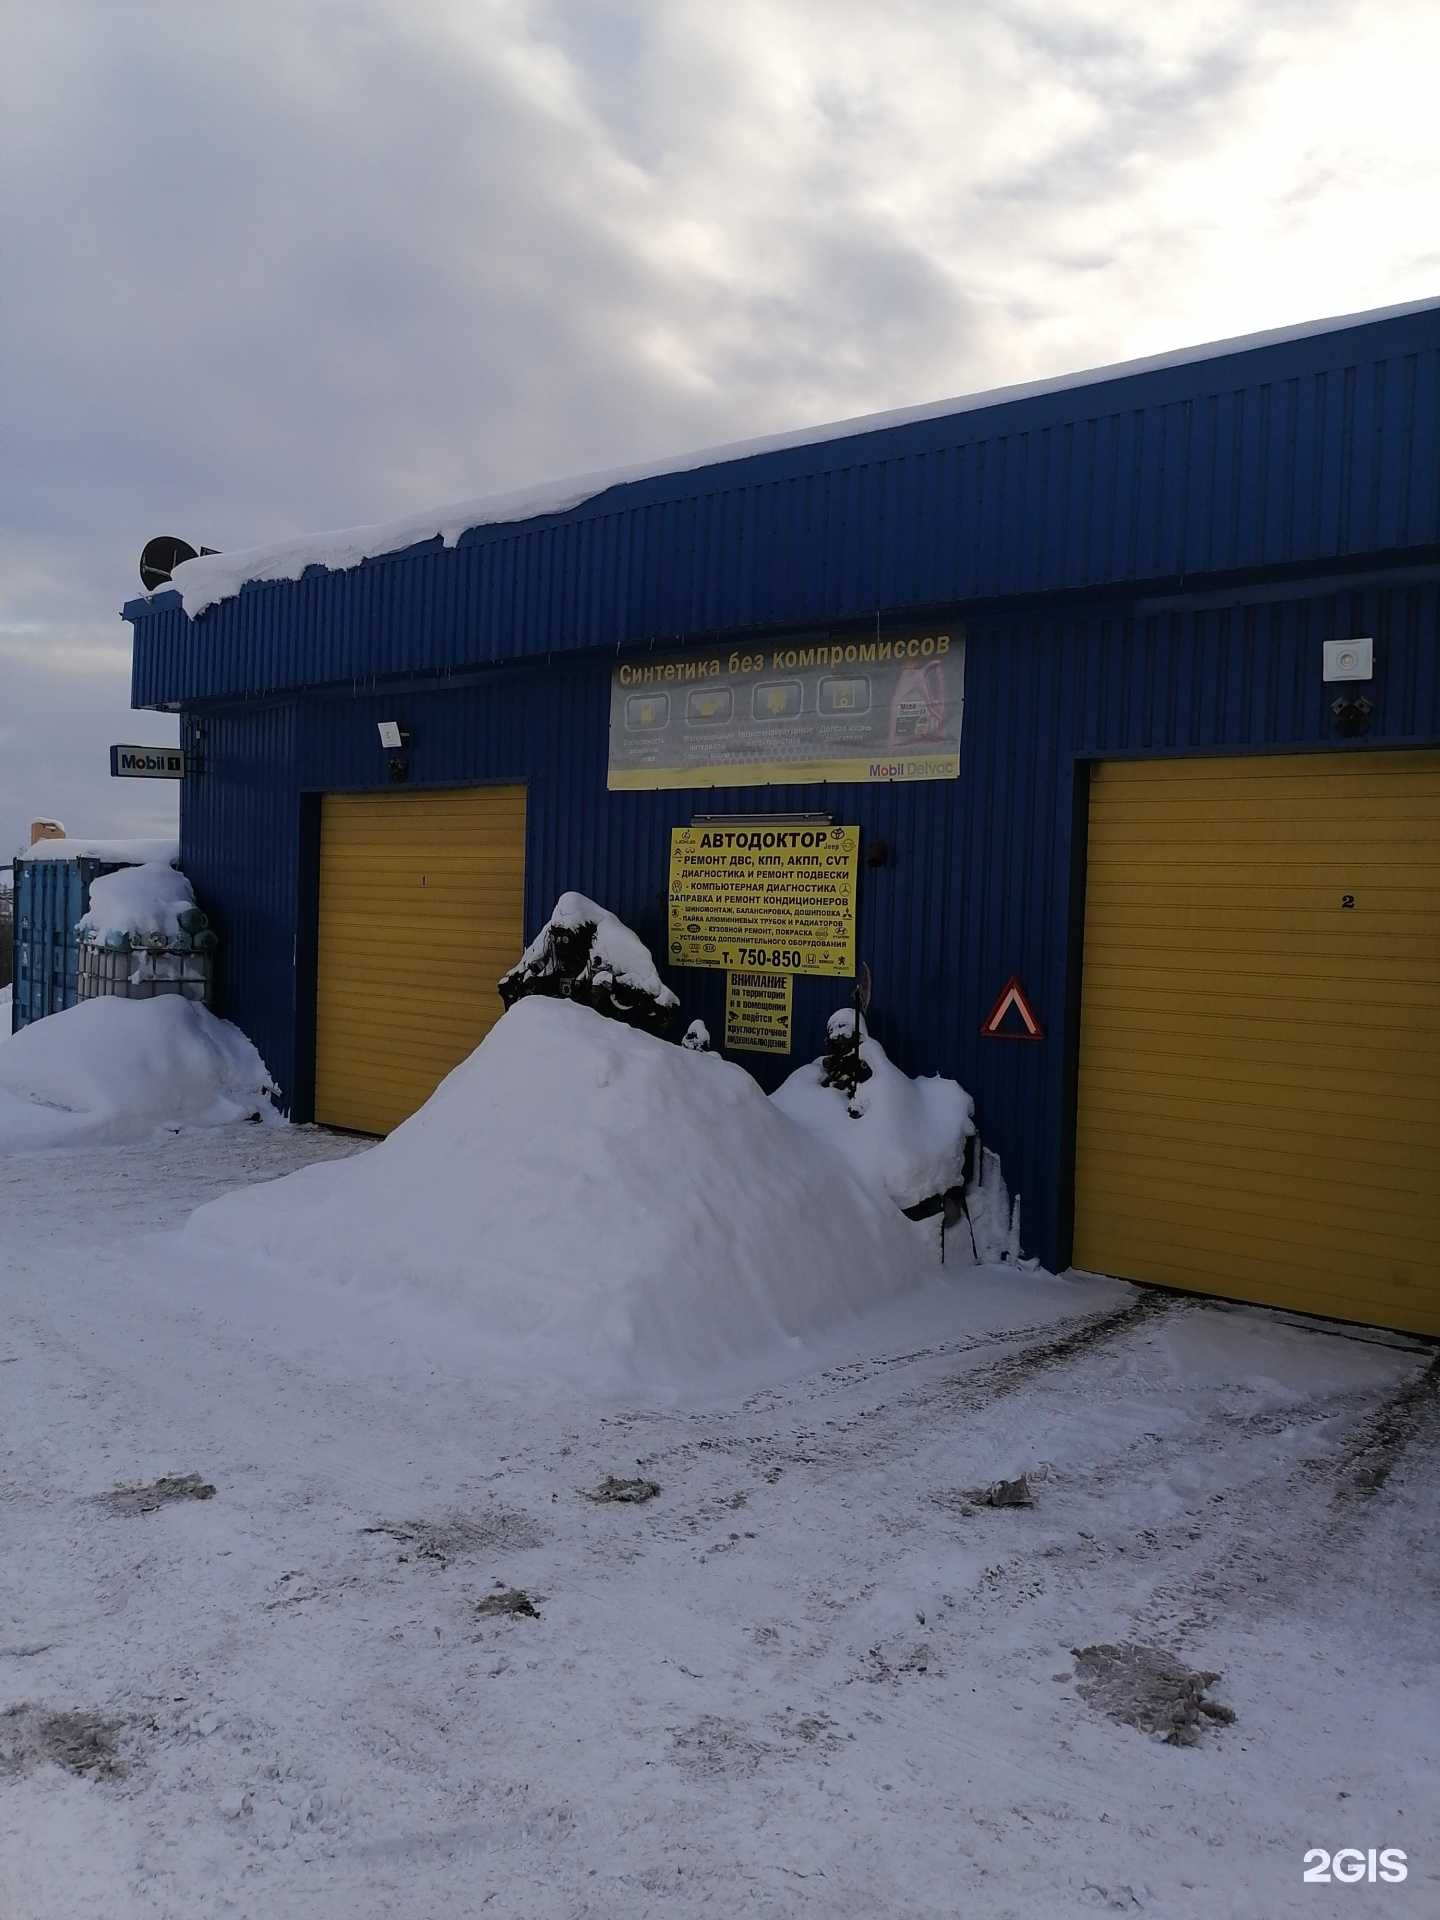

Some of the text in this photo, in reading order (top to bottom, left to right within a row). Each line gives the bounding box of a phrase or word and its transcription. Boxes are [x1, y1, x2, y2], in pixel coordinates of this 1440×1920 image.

[619, 635, 950, 685] Синтетика без компромиссов
[121, 754, 165, 770] Mobil
[869, 762, 954, 777] Mobil Delvac
[701, 832, 827, 850] АВТОДОКТОР
[684, 856, 849, 866] РЕМОНТ ДВС, КПП, АКПП, CVT
[682, 870, 744, 878] ДИАГНОСТИКА
[757, 871, 793, 879] РЕМОНТ
[797, 871, 849, 880] ПОДВЕСКИ
[691, 883, 836, 893] КОМПЬЮТЕРНАЯ ДИАГНОСТИКА
[725, 896, 760, 904] РЕМОНТ
[763, 896, 848, 906] КОНДИЦИОНЕРОВ
[1342, 895, 1354, 908] 2
[795, 919, 843, 928] РАДИАТОРОВ
[744, 927, 774, 936] РЕМОНТ,
[776, 928, 812, 937] ПОКРАСКА
[739, 948, 801, 968] 750-850
[732, 973, 787, 989] ВНИМАНИЕ
